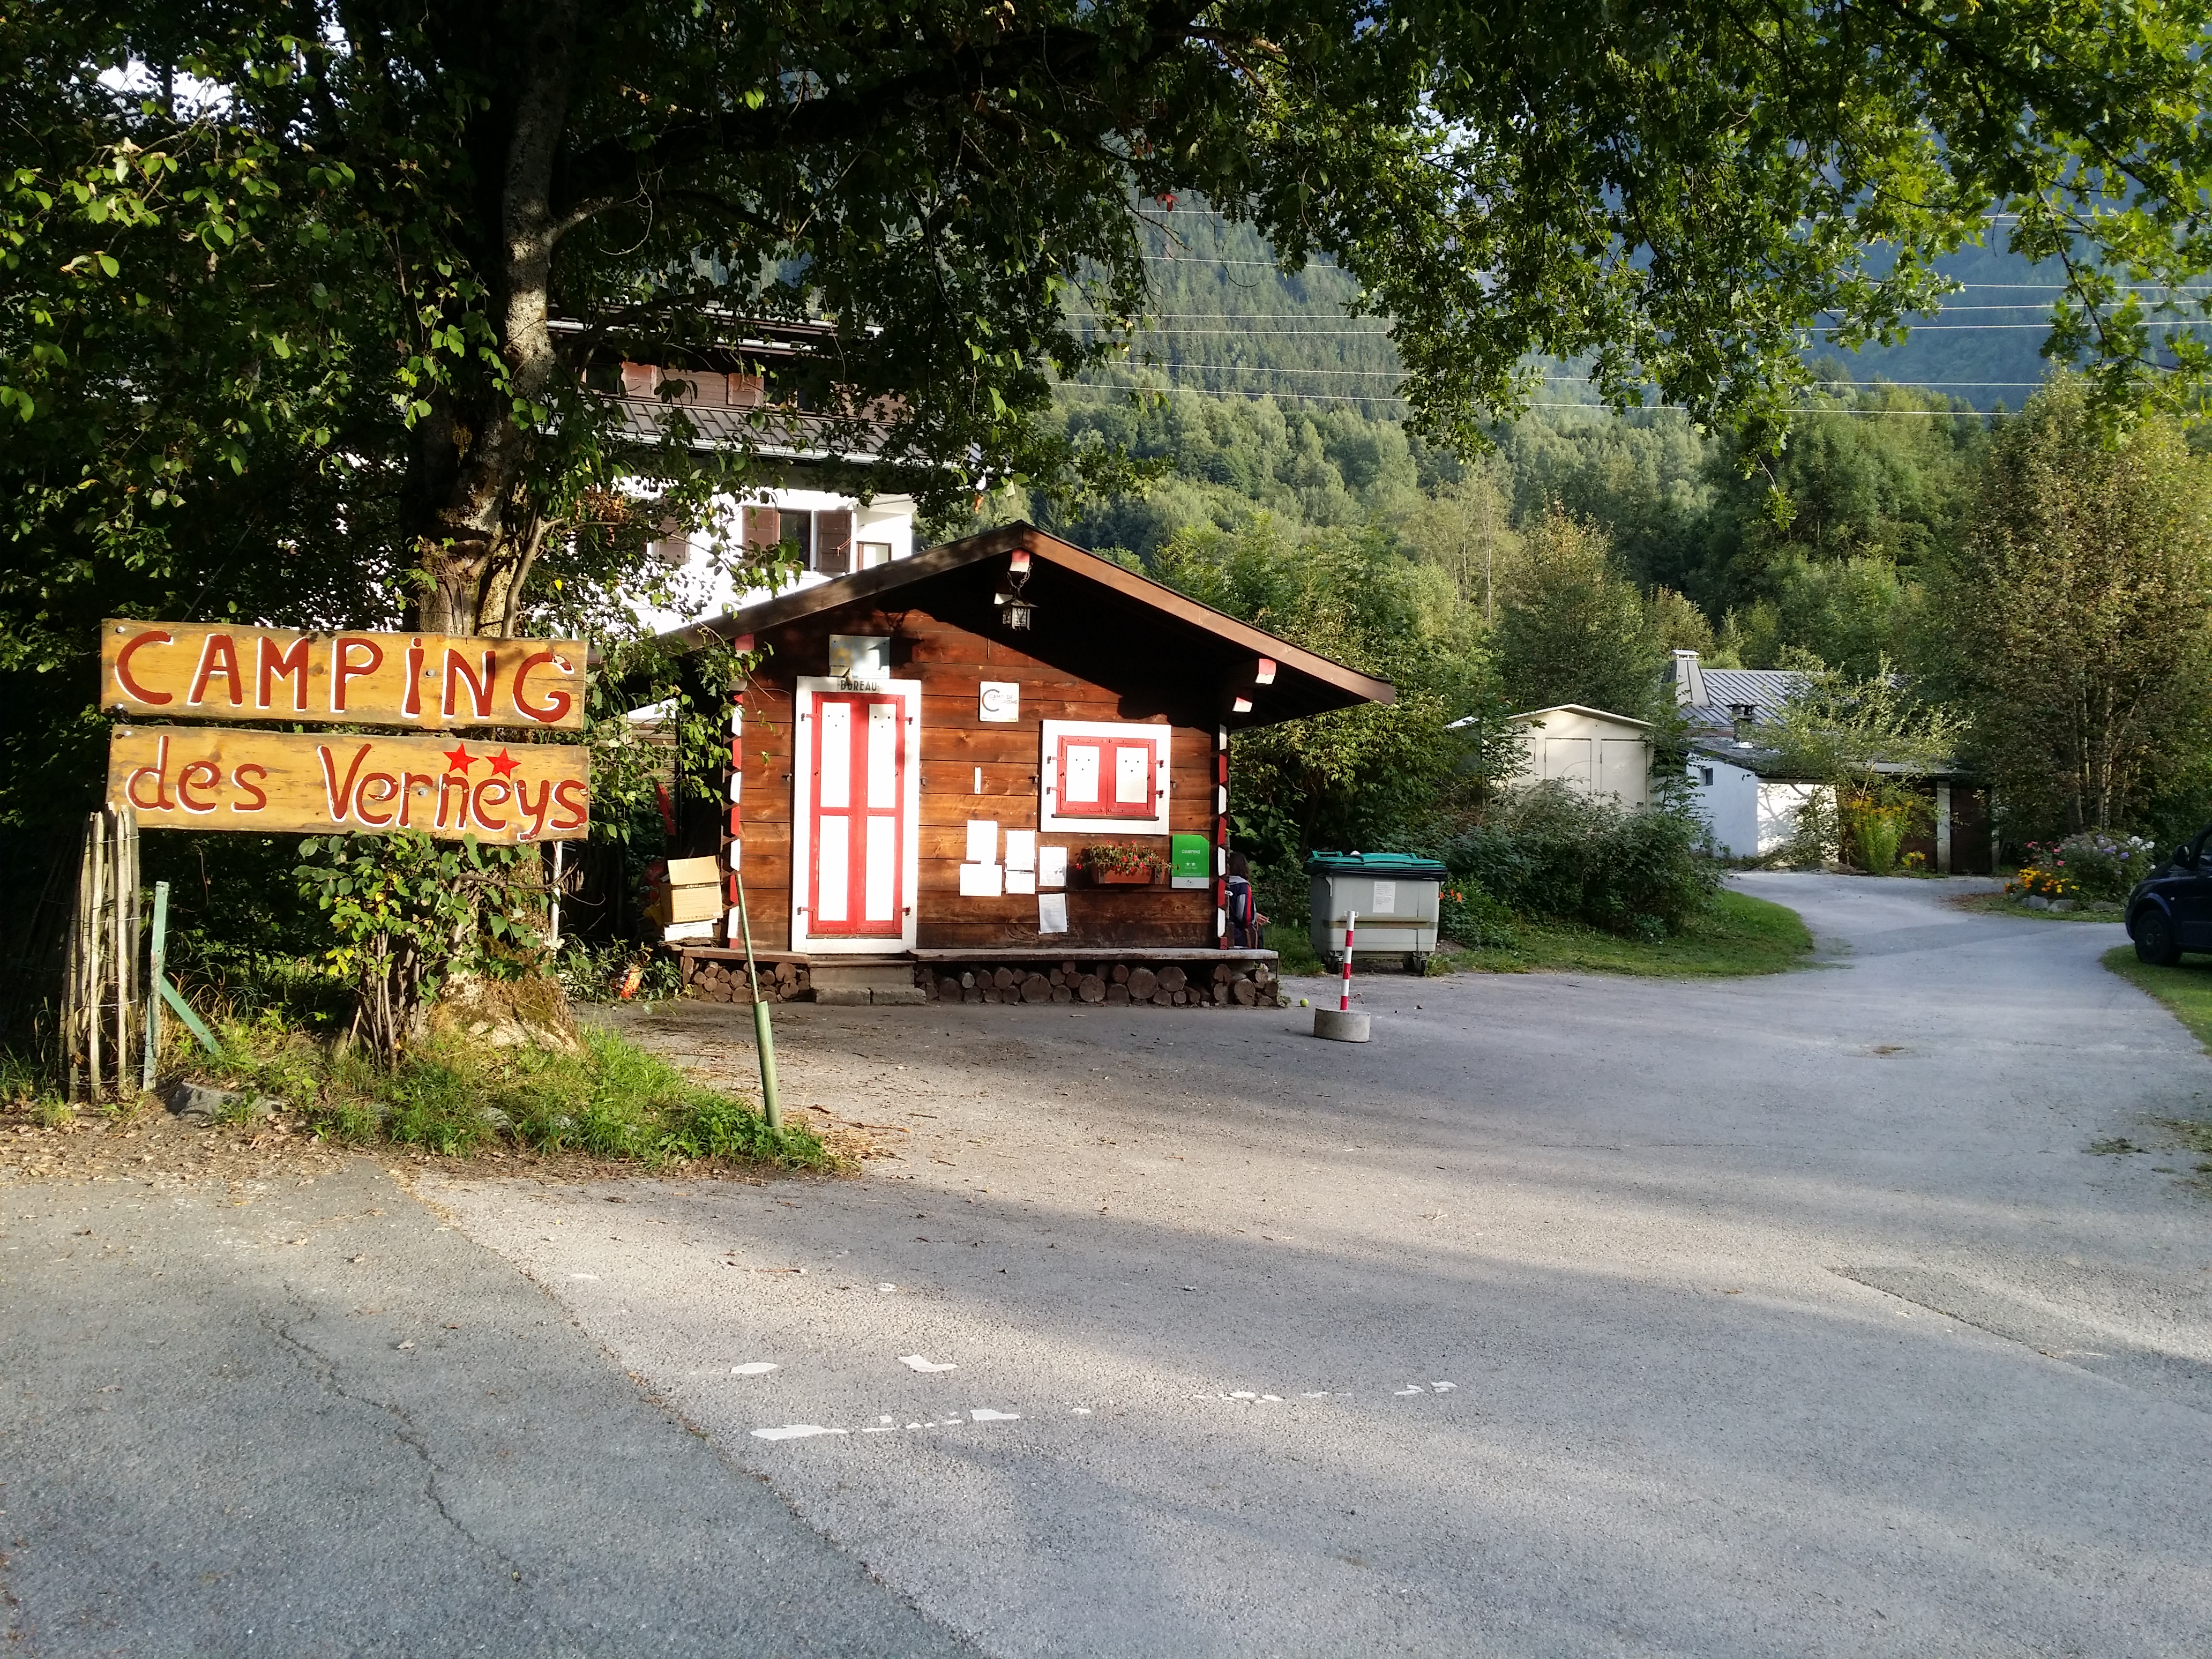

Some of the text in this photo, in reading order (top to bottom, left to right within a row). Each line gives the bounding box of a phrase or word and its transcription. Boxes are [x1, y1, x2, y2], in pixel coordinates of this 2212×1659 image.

[840, 679, 877, 691] BUREAU
[125, 735, 588, 842] des Verneys
